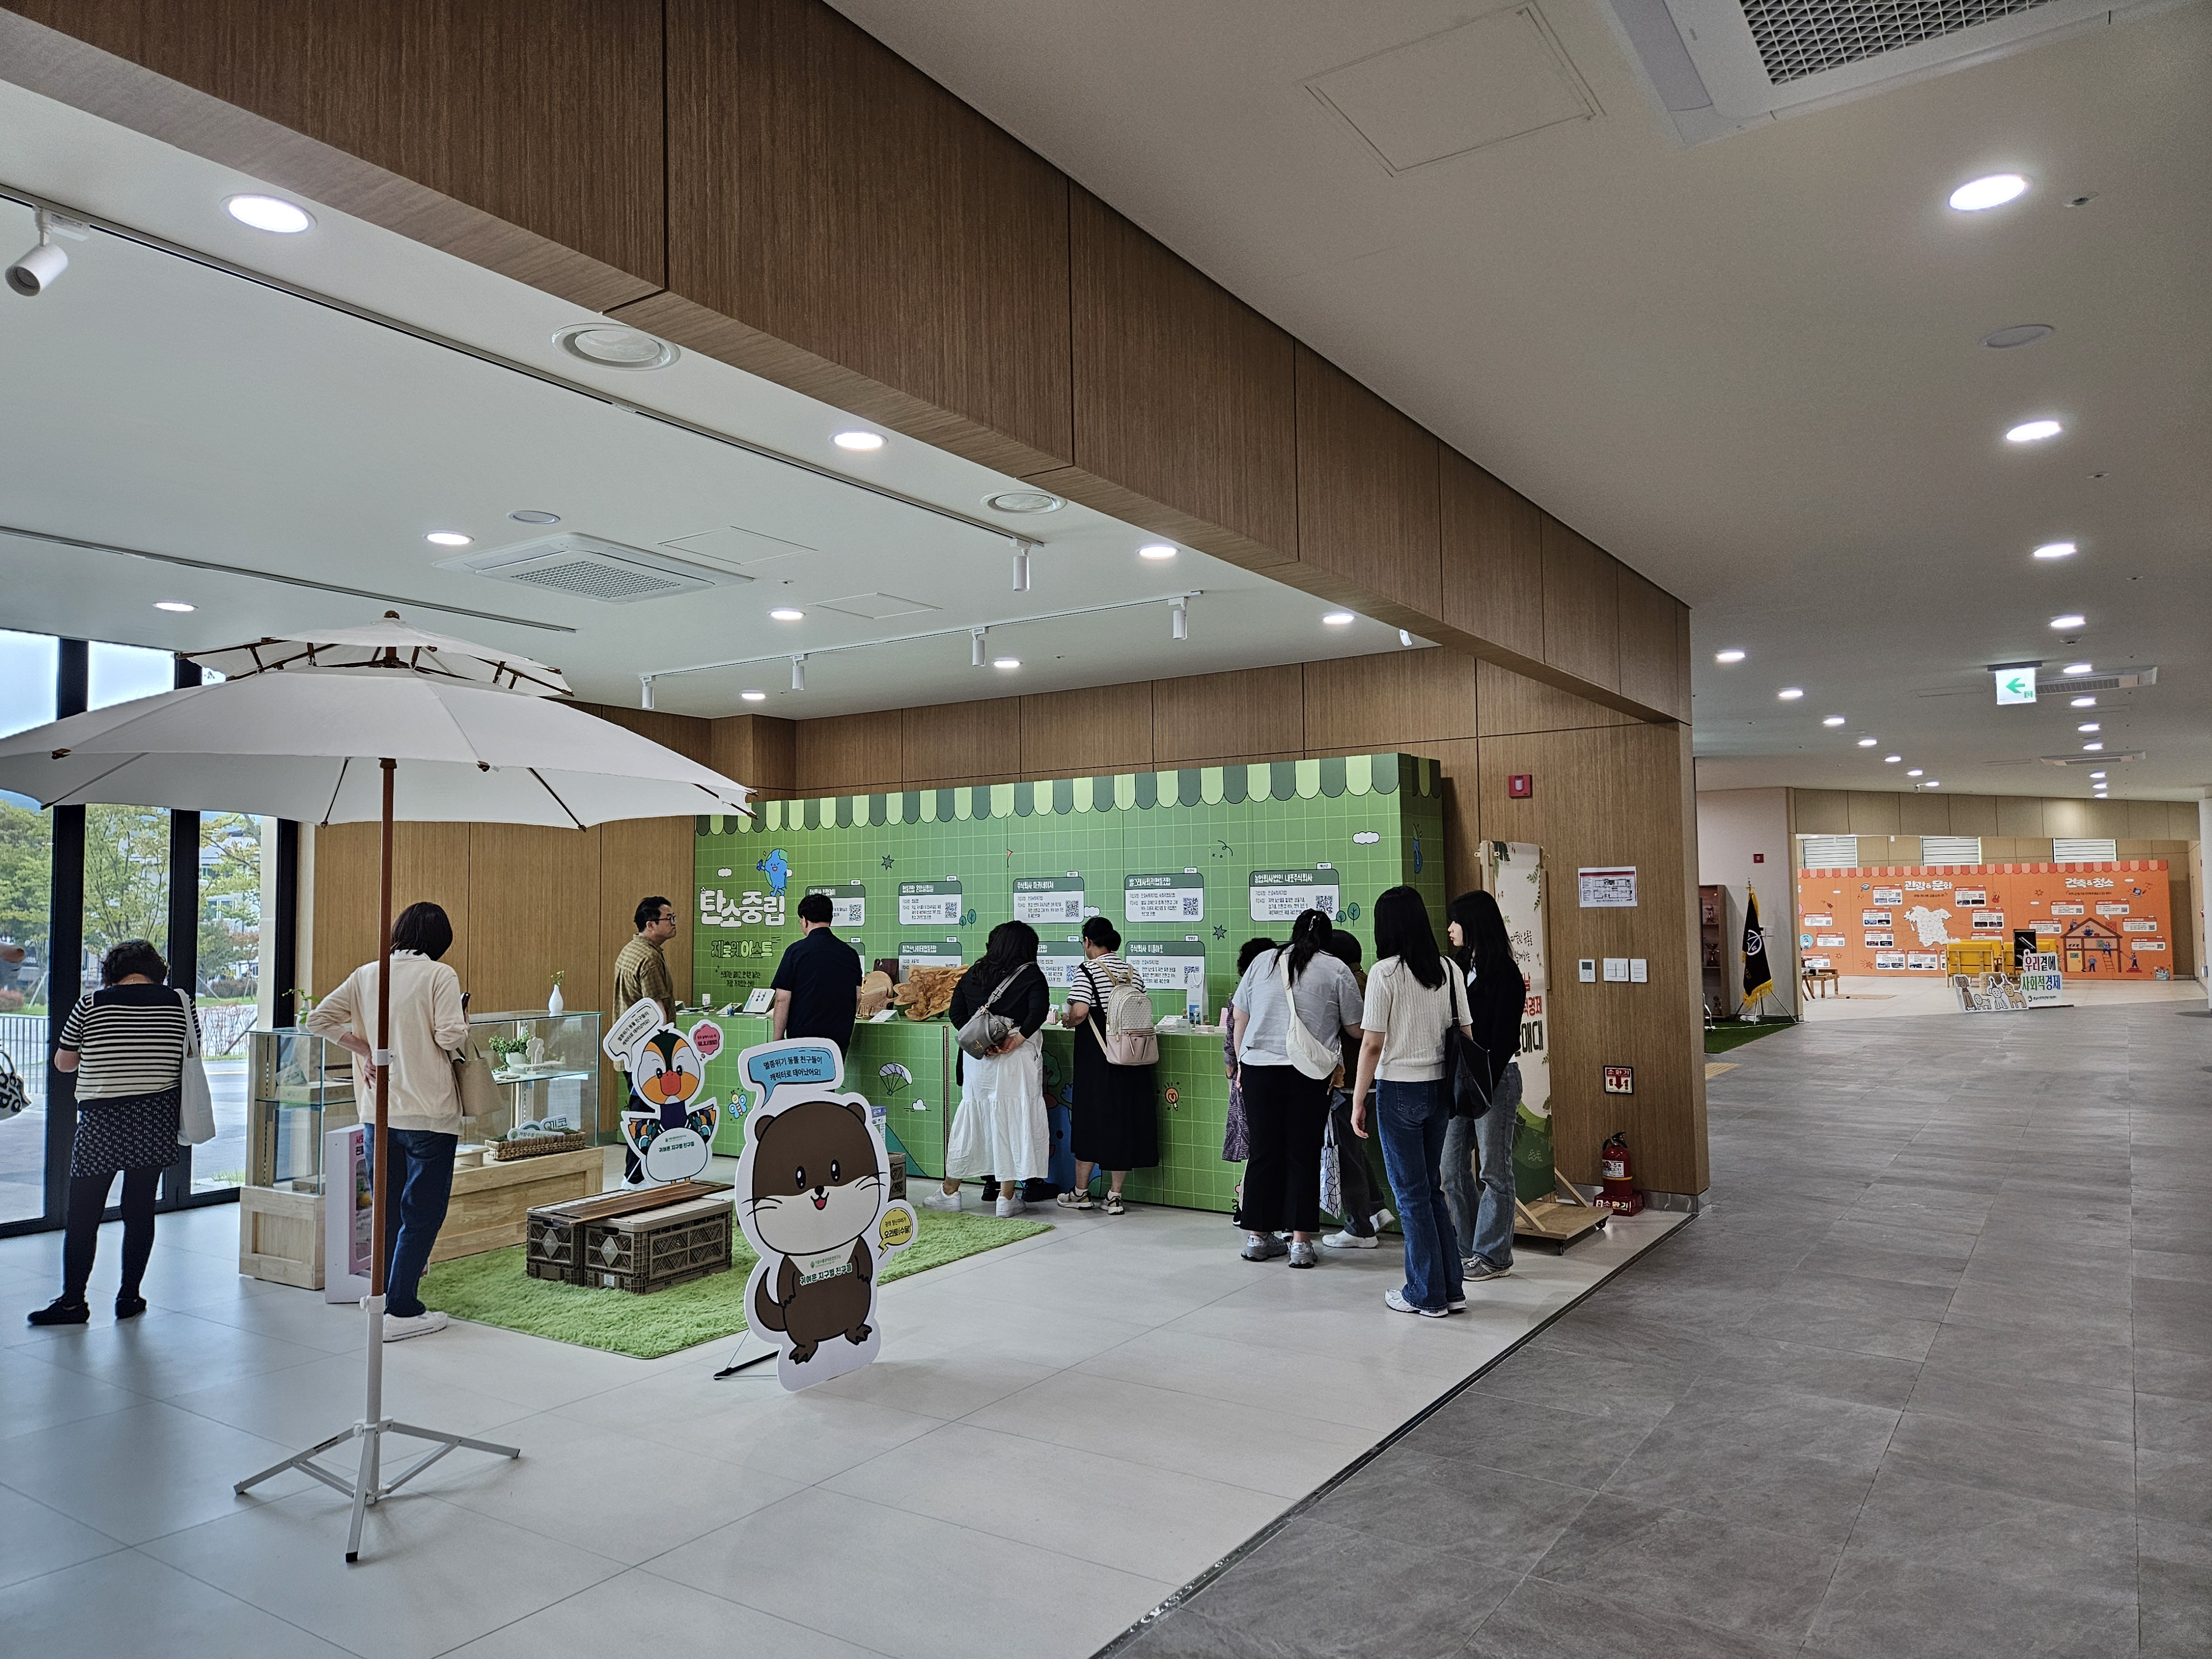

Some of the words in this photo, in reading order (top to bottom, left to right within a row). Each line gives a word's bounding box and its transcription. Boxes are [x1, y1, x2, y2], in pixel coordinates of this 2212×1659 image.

[1129, 877, 1171, 886] 발그래사회적협동조합
[1255, 874, 1283, 883] 농업회사법인
[1904, 879, 1953, 891] 관광&문화
[2065, 878, 2114, 888] 건축&청소
[700, 888, 785, 928] 탄소중립
[711, 940, 773, 958] 제로웨이스트
[1130, 945, 1147, 953] 주식회사
[2025, 956, 2056, 972] 우리곁에
[2022, 975, 2060, 991] 사회적경제
[617, 1027, 630, 1041] 멸종위기
[635, 1011, 650, 1023] 친구들이
[763, 1057, 787, 1070] 멸종위기
[787, 1056, 799, 1065] 동물
[800, 1055, 822, 1064] 친구들이
[770, 1070, 792, 1081] 캐릭터로
[792, 1068, 821, 1077] 태어났어요!
[1603, 1200, 1628, 1209] 소화기
[884, 1224, 911, 1239] 오리토(수달)
[800, 1273, 817, 1285] 귀여운
[818, 1268, 834, 1280] 지구별
[836, 1264, 852, 1275] 친구들
